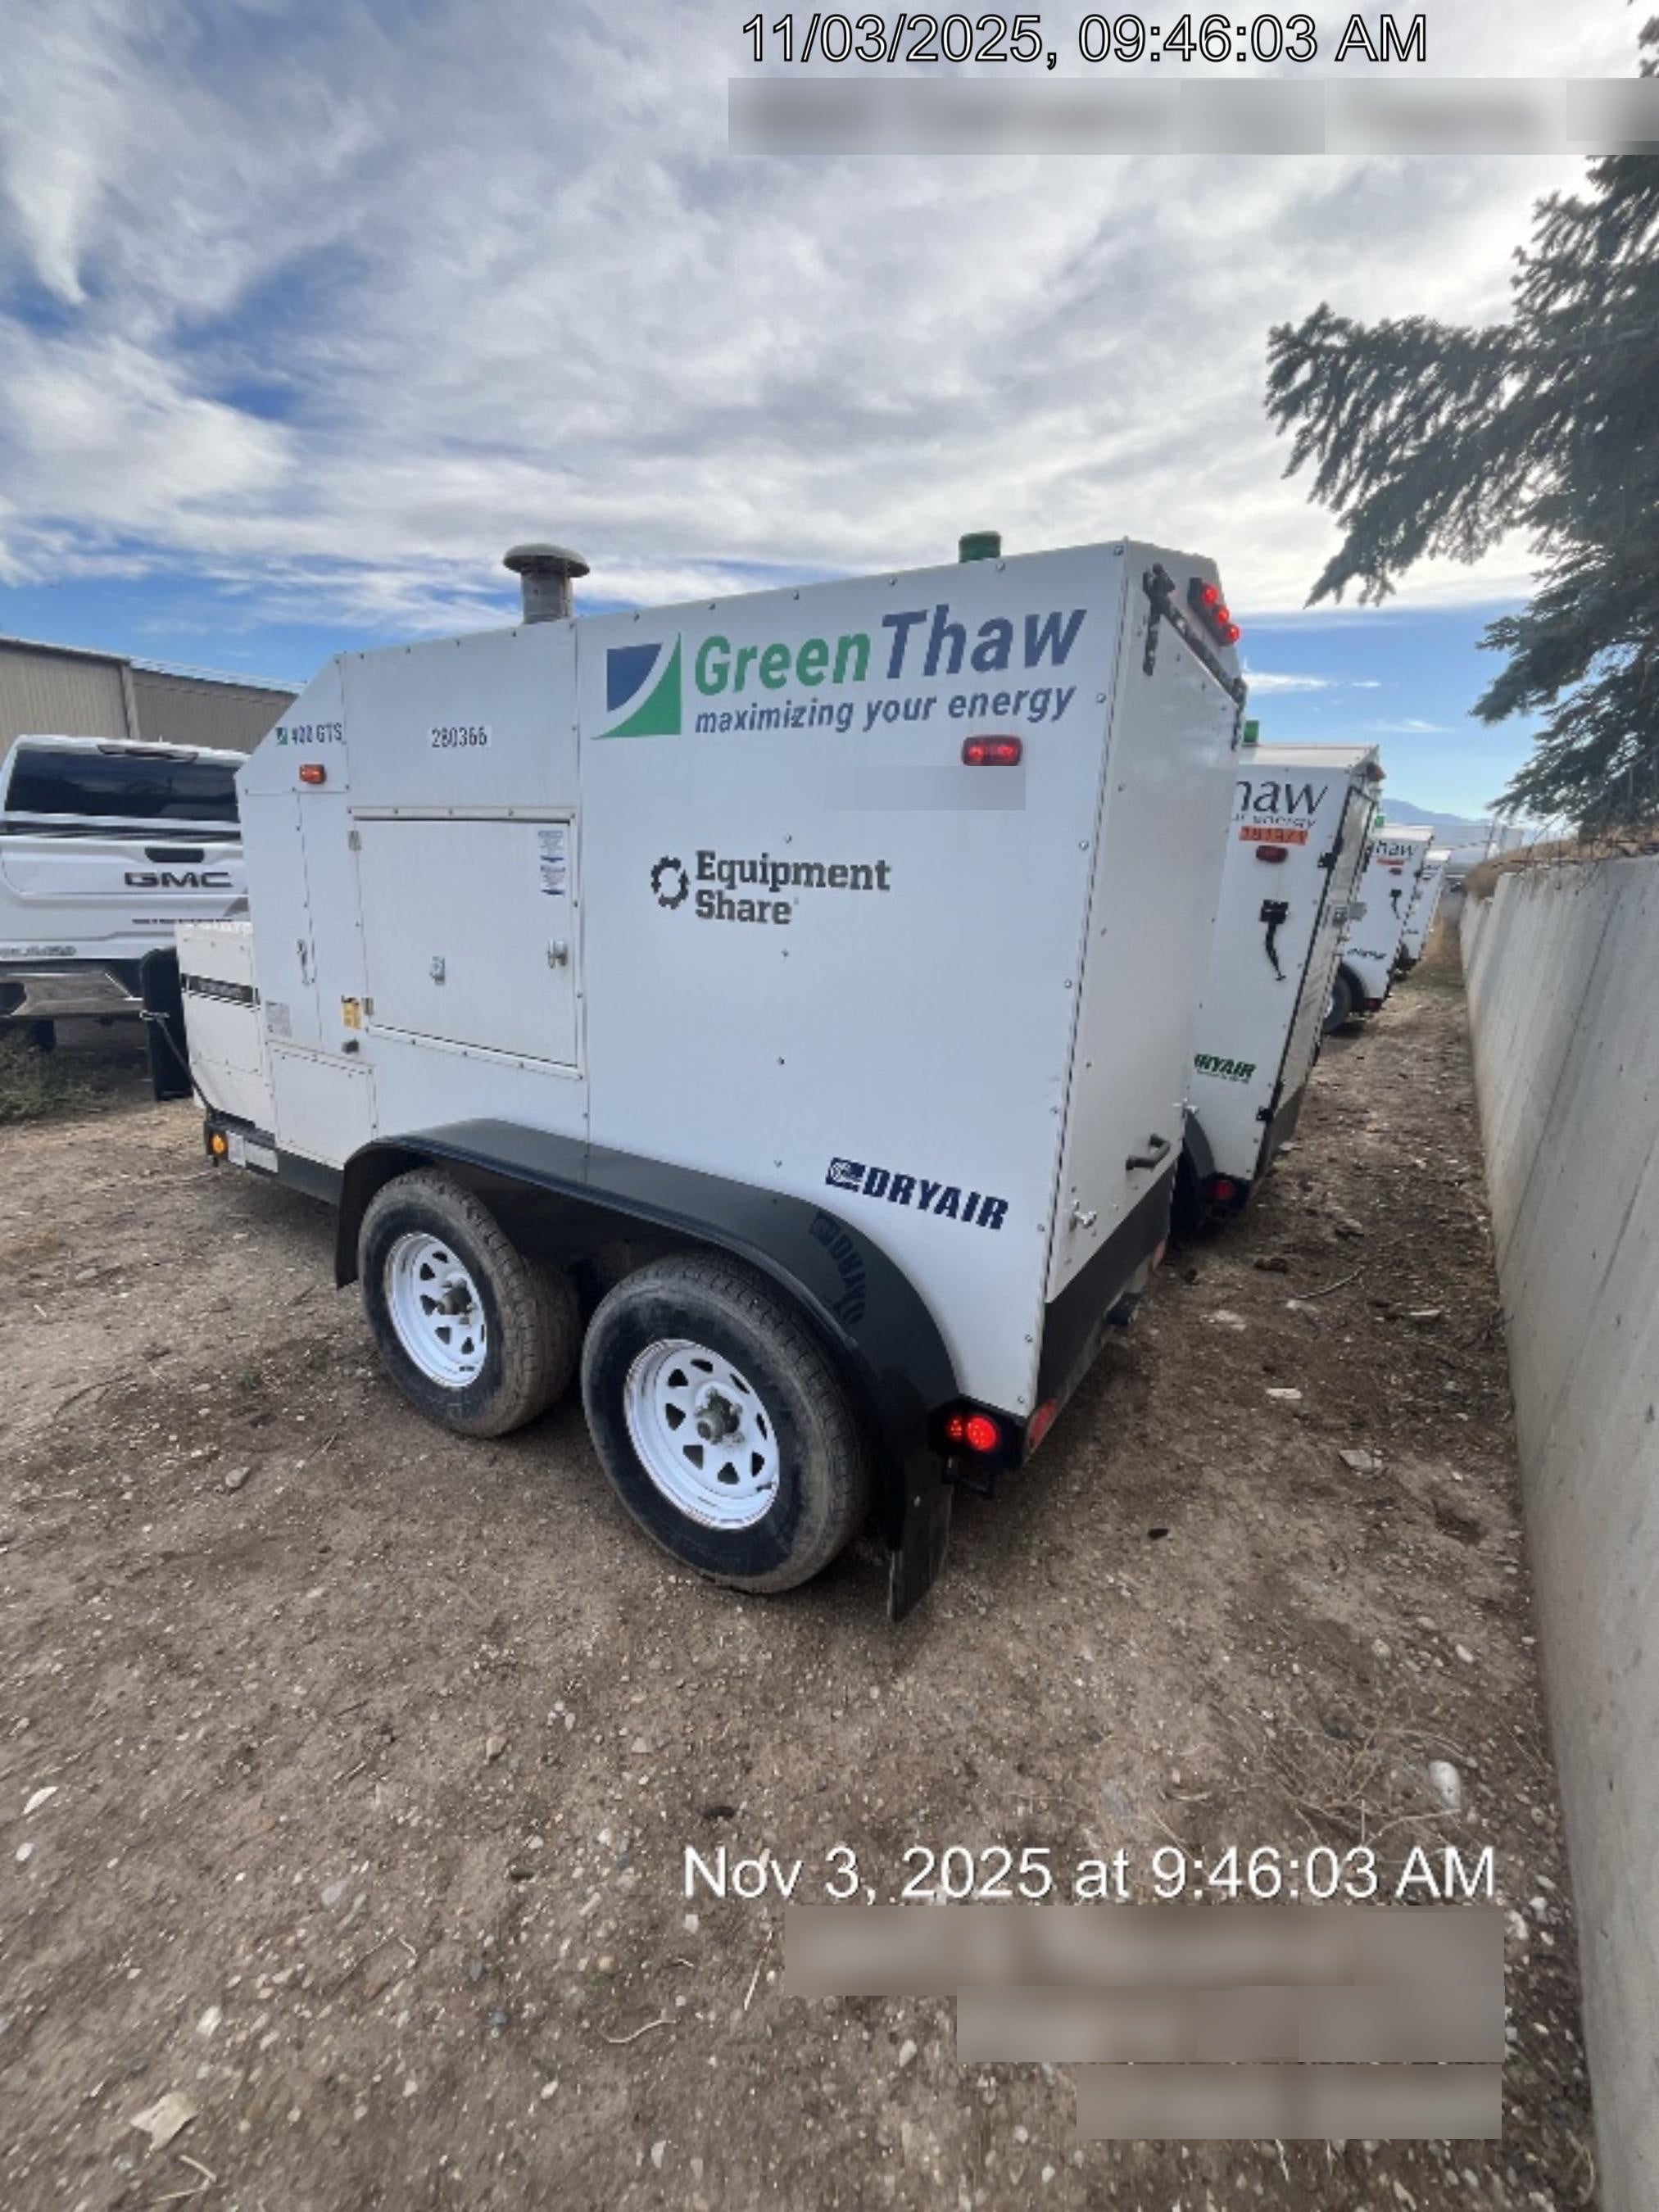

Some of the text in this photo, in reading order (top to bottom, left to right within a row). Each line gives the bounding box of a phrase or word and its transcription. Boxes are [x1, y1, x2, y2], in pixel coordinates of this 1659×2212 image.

[695, 603, 1087, 696] GreenThaw
[695, 685, 1077, 733] maximizing your energy
[124, 872, 233, 887] GMC
[696, 850, 891, 892] Equipment
[696, 889, 792, 925] Share
[863, 1167, 1009, 1230] DRYAIR
